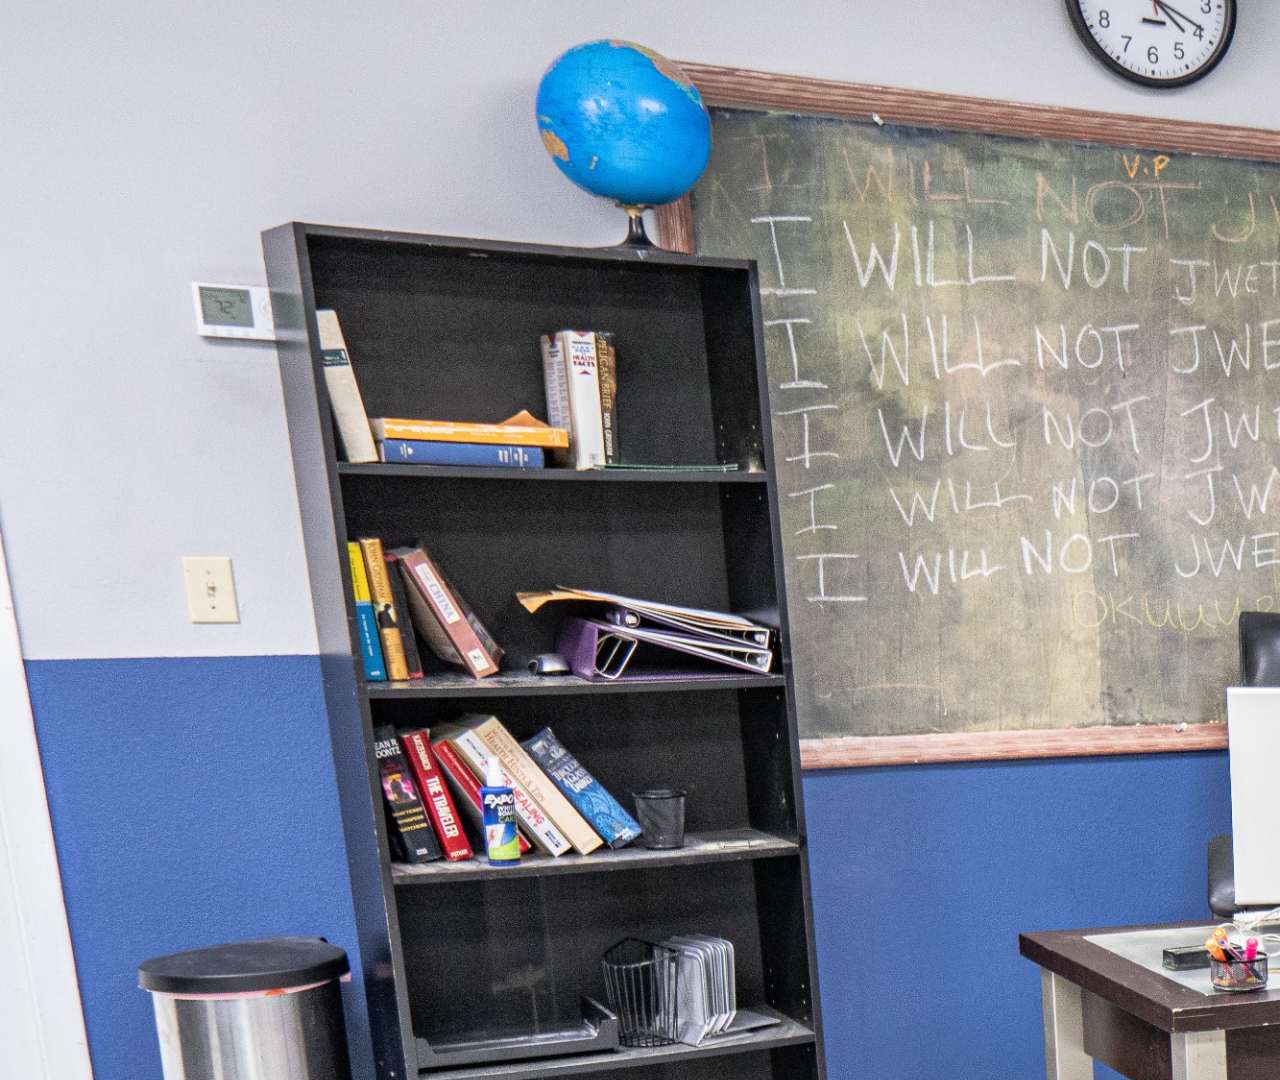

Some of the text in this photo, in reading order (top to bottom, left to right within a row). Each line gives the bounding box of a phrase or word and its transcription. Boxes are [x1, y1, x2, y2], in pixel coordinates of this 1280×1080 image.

[1098, 10, 1110, 28] 8
[1121, 35, 1132, 52] 7
[1174, 42, 1184, 60] 5
[1147, 46, 1159, 64] 6
[842, 147, 1011, 207] WILL
[1036, 170, 1200, 239] NOT
[751, 216, 817, 295] I
[842, 220, 1016, 290] WILL
[1041, 227, 1147, 293] NOT
[764, 318, 829, 389] I
[856, 313, 1021, 389] WILL
[1034, 323, 1140, 373] NOT
[776, 404, 840, 469] I
[877, 400, 1017, 468] WILL
[1043, 395, 1151, 454] NOT
[787, 483, 838, 535] I
[889, 478, 1032, 527] WILL
[1052, 474, 1156, 519] NOT
[796, 553, 869, 604] I
[898, 548, 1009, 595] WILL
[1020, 529, 1140, 577] NOT
